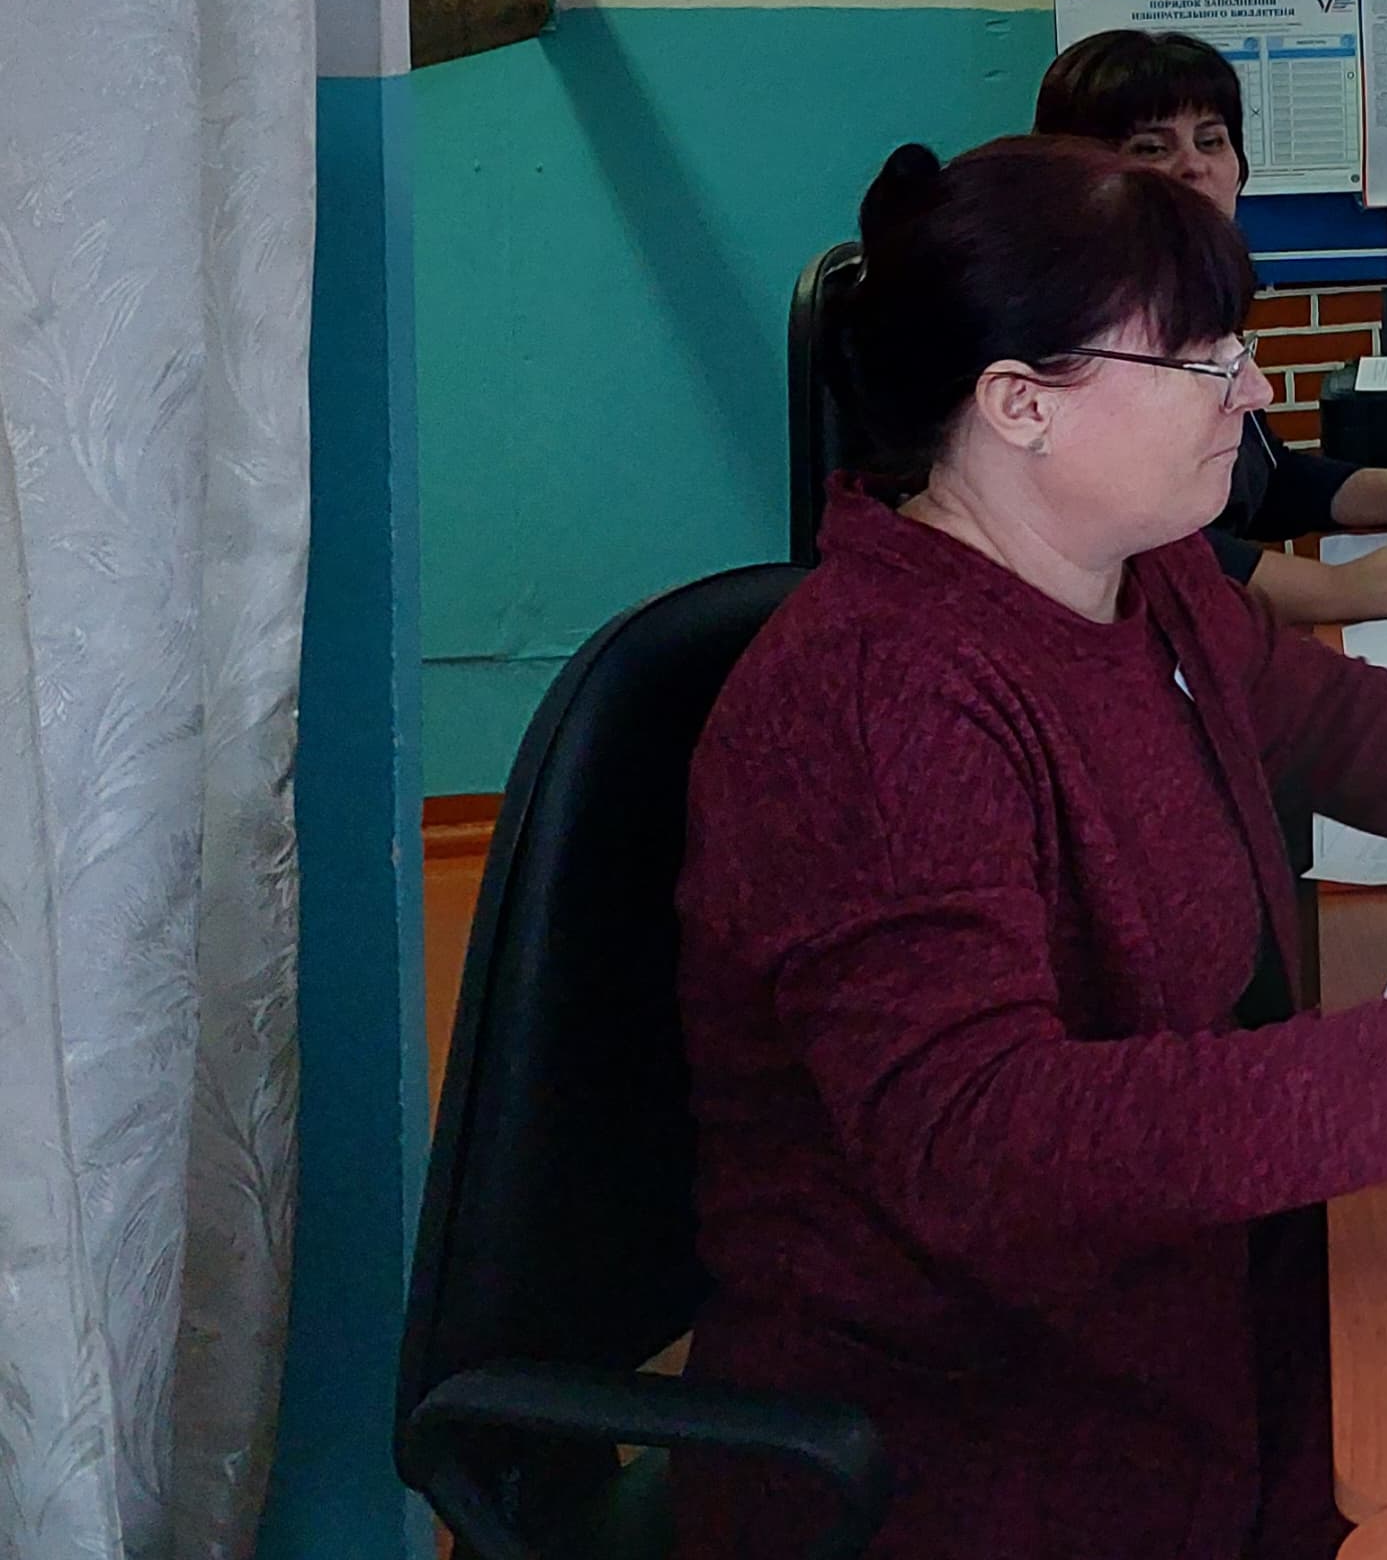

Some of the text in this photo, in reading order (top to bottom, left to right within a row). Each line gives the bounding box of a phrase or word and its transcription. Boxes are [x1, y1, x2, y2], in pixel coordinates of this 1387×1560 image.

[1150, 0, 1200, 9] ПОРЯДОК
[1131, 7, 1295, 20] ИЗБИРАТЕЛЬНОГО БЮЛЛЕТЕНЯ
